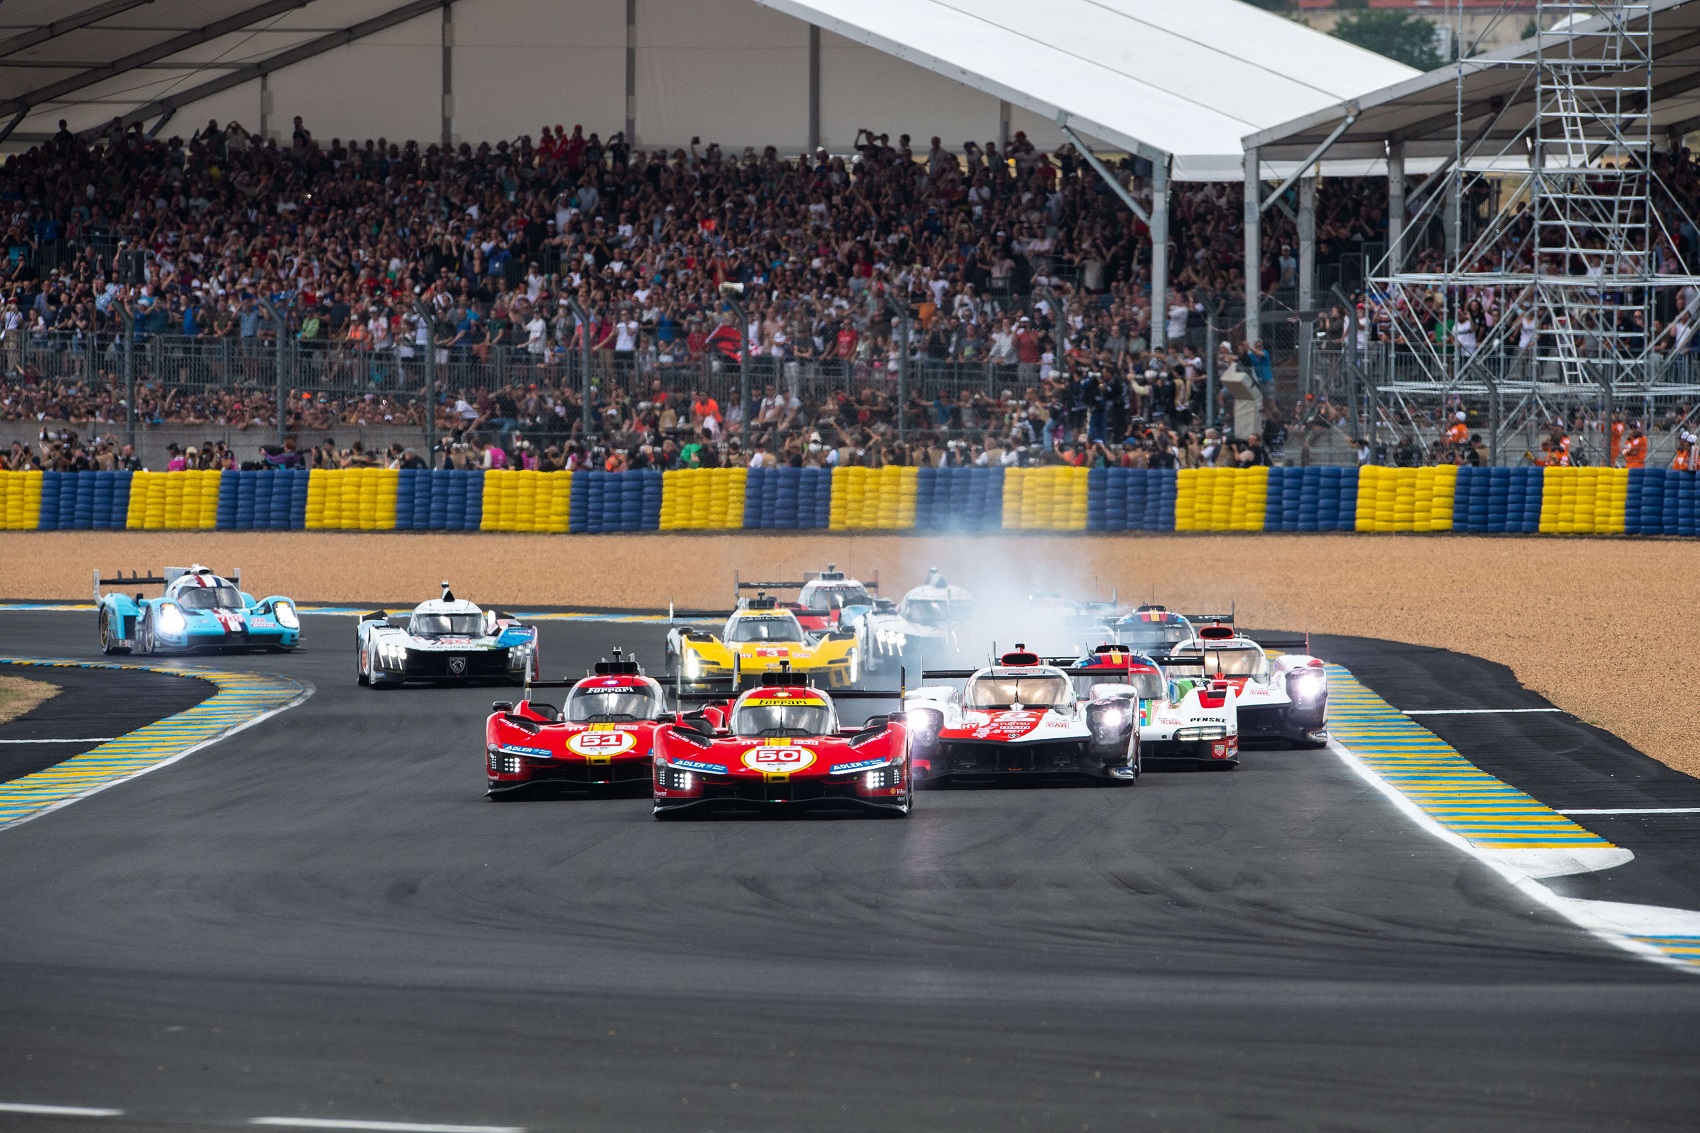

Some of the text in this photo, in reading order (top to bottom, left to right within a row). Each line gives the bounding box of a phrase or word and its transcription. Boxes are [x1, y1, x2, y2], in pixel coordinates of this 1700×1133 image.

[582, 735, 621, 746] 51
[505, 745, 533, 753] ADLER
[758, 750, 800, 761] 50
[674, 760, 706, 768] ADLER
[833, 762, 864, 770] ADLER
